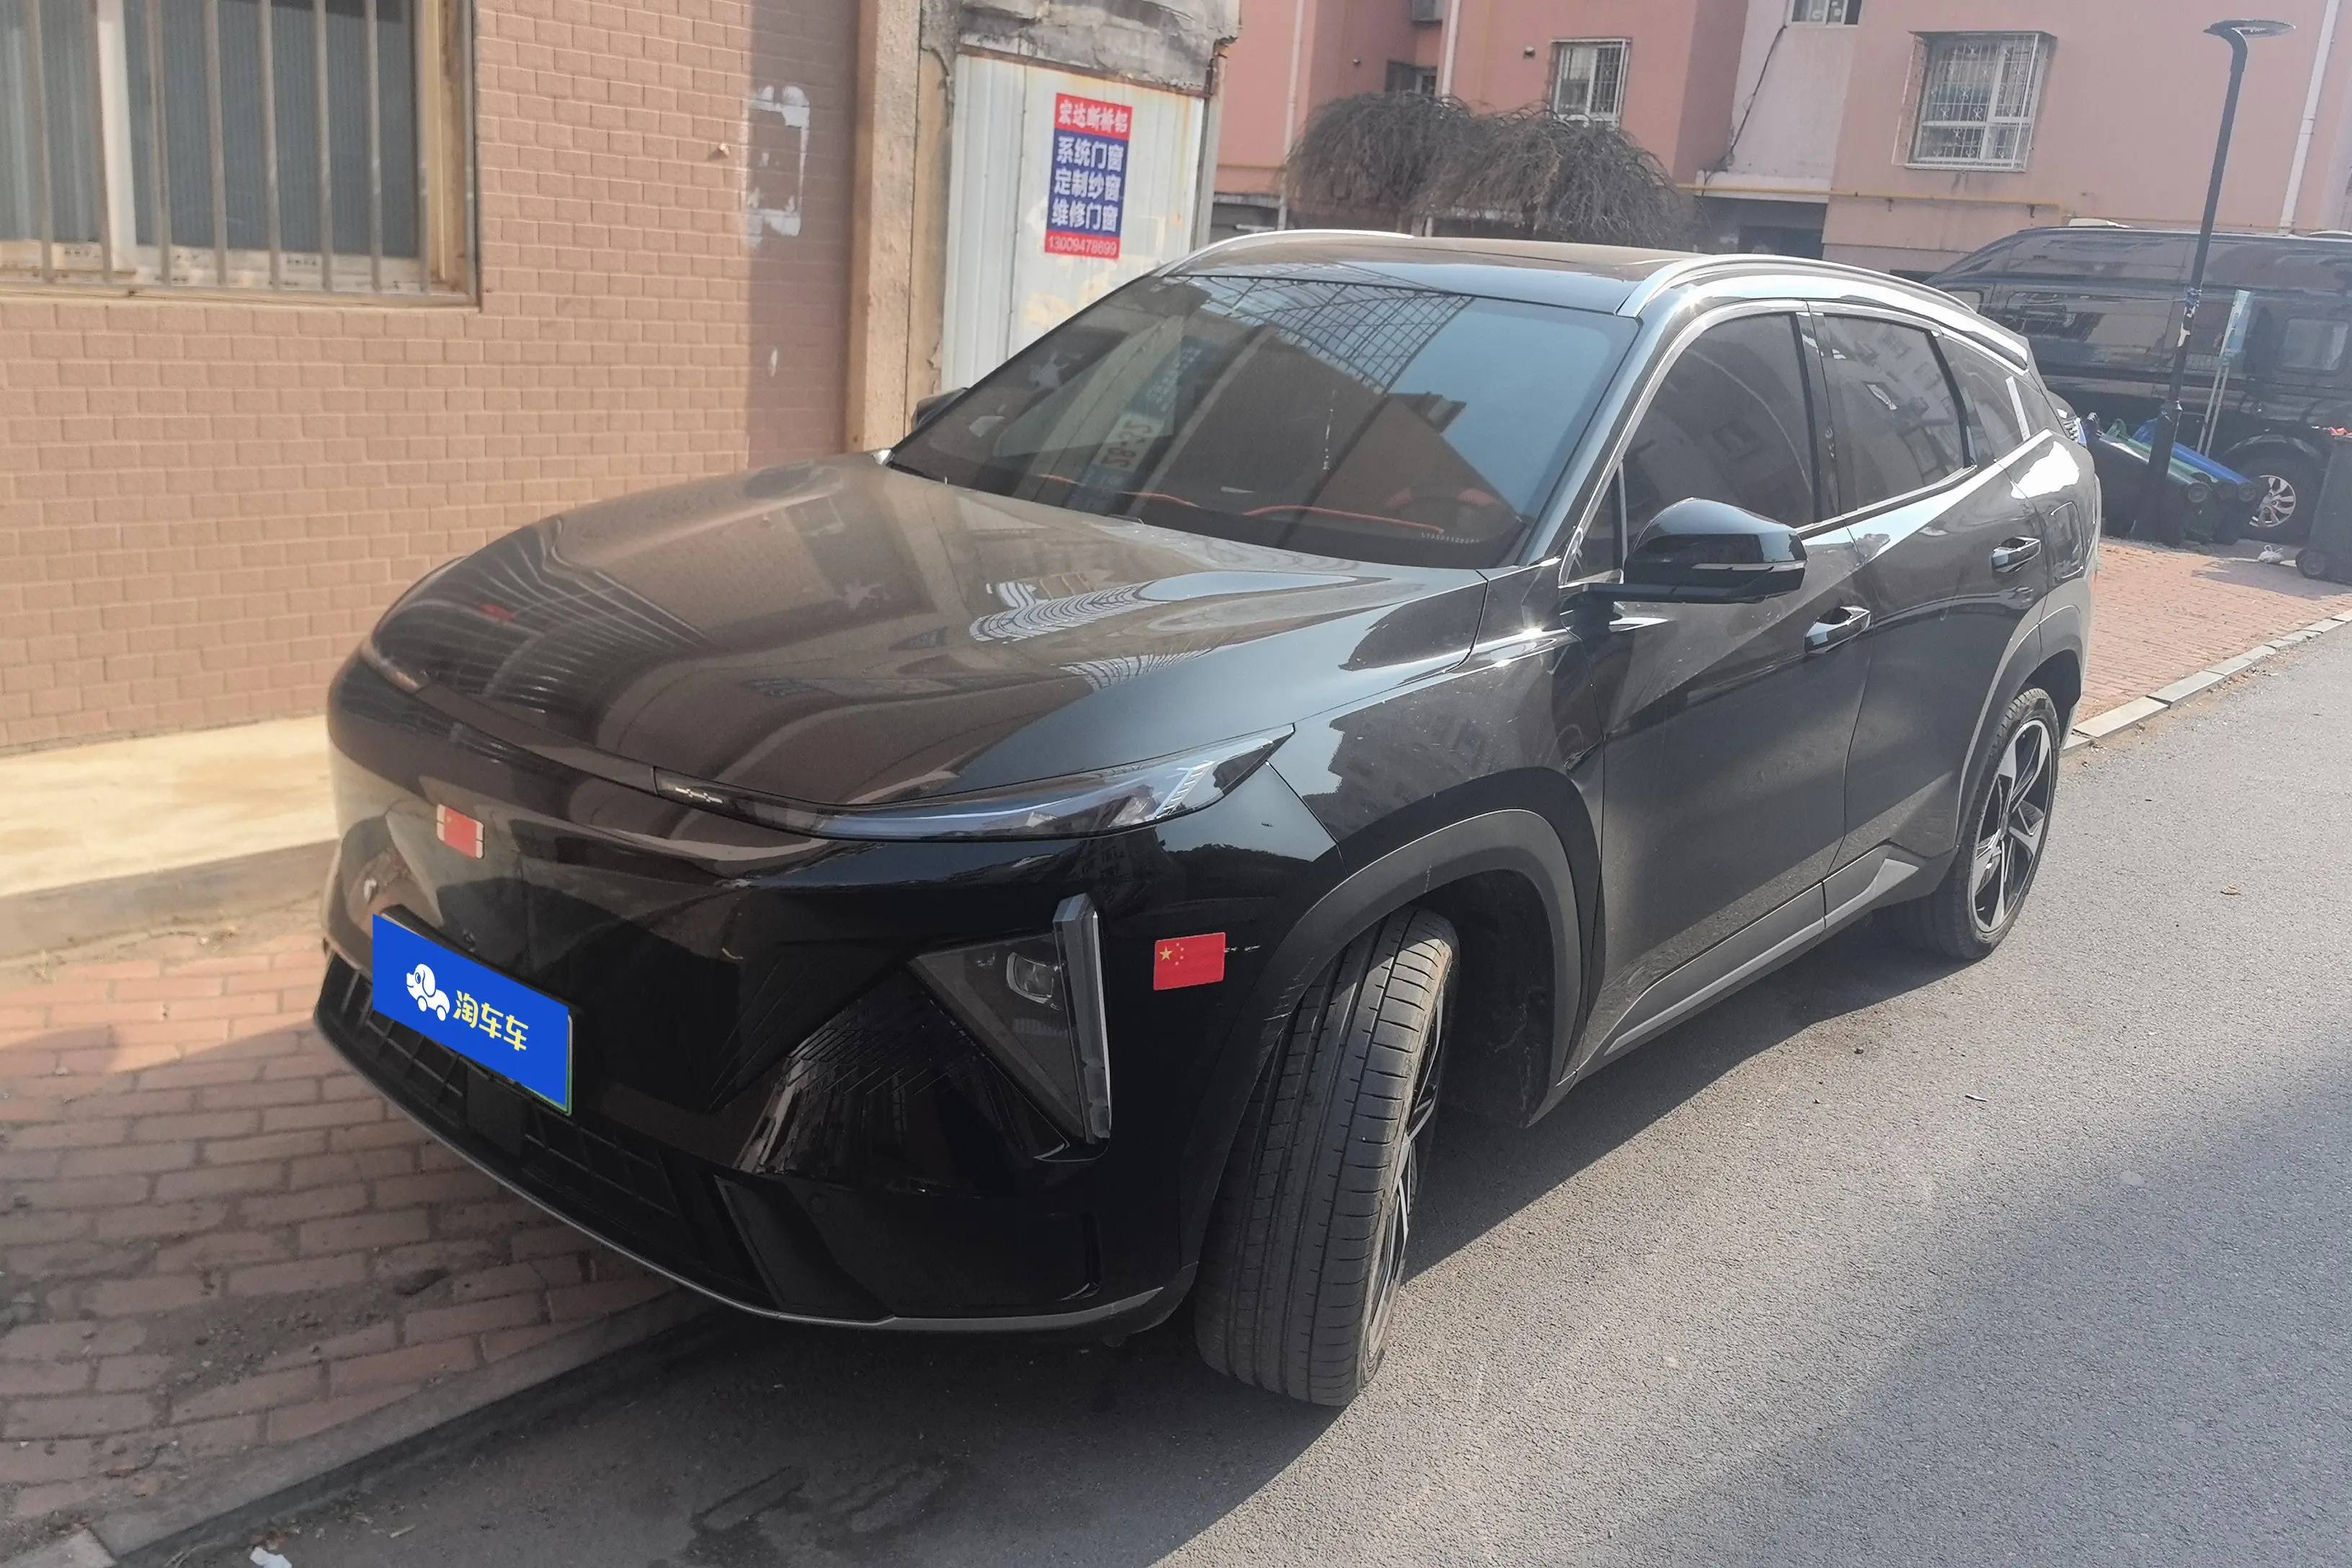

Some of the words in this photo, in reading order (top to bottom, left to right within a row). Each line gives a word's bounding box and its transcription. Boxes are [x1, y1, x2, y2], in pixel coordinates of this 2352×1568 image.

[1057, 136, 1123, 172] 系统门窗
[1054, 166, 1121, 202] 定制纱窗
[1051, 197, 1118, 231] 维修门窗
